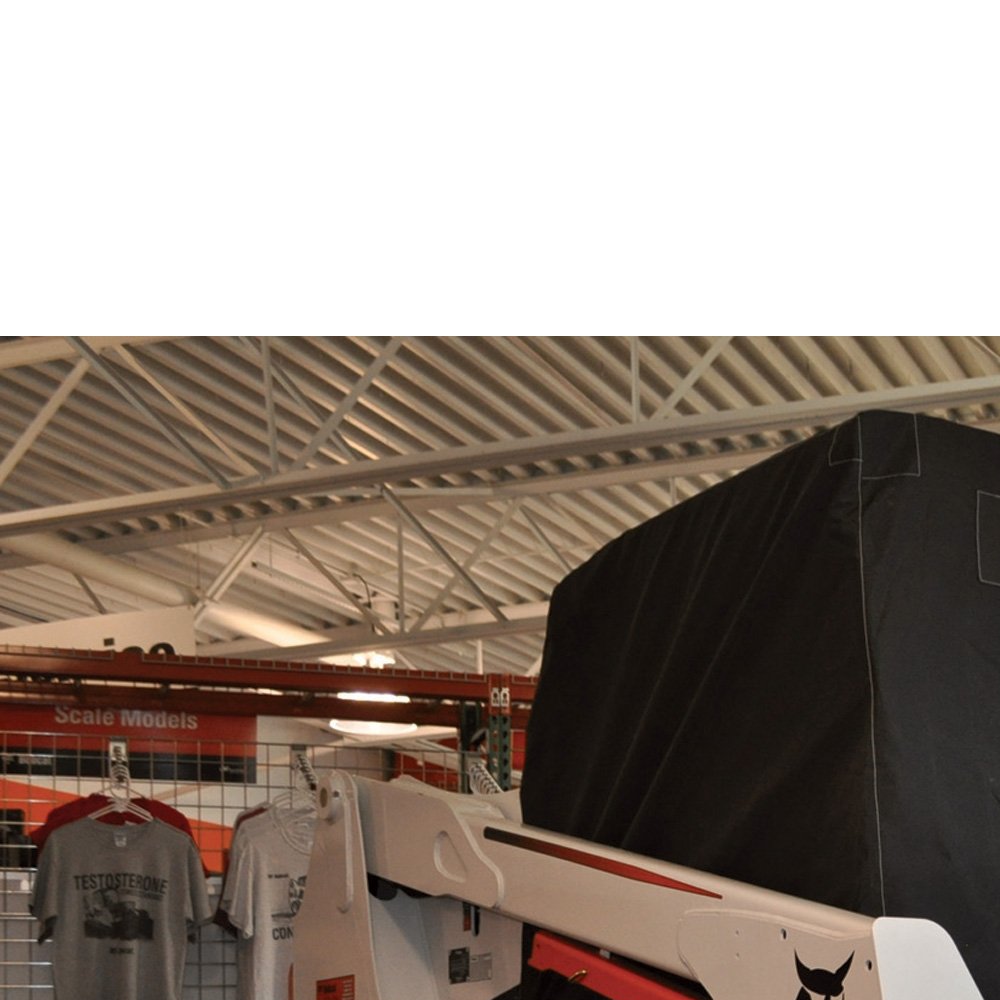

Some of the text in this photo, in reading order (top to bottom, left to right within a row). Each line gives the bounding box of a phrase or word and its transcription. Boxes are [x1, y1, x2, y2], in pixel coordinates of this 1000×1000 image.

[55, 706, 198, 730] Scale Models
[73, 871, 169, 895] TESTOSTERONE
